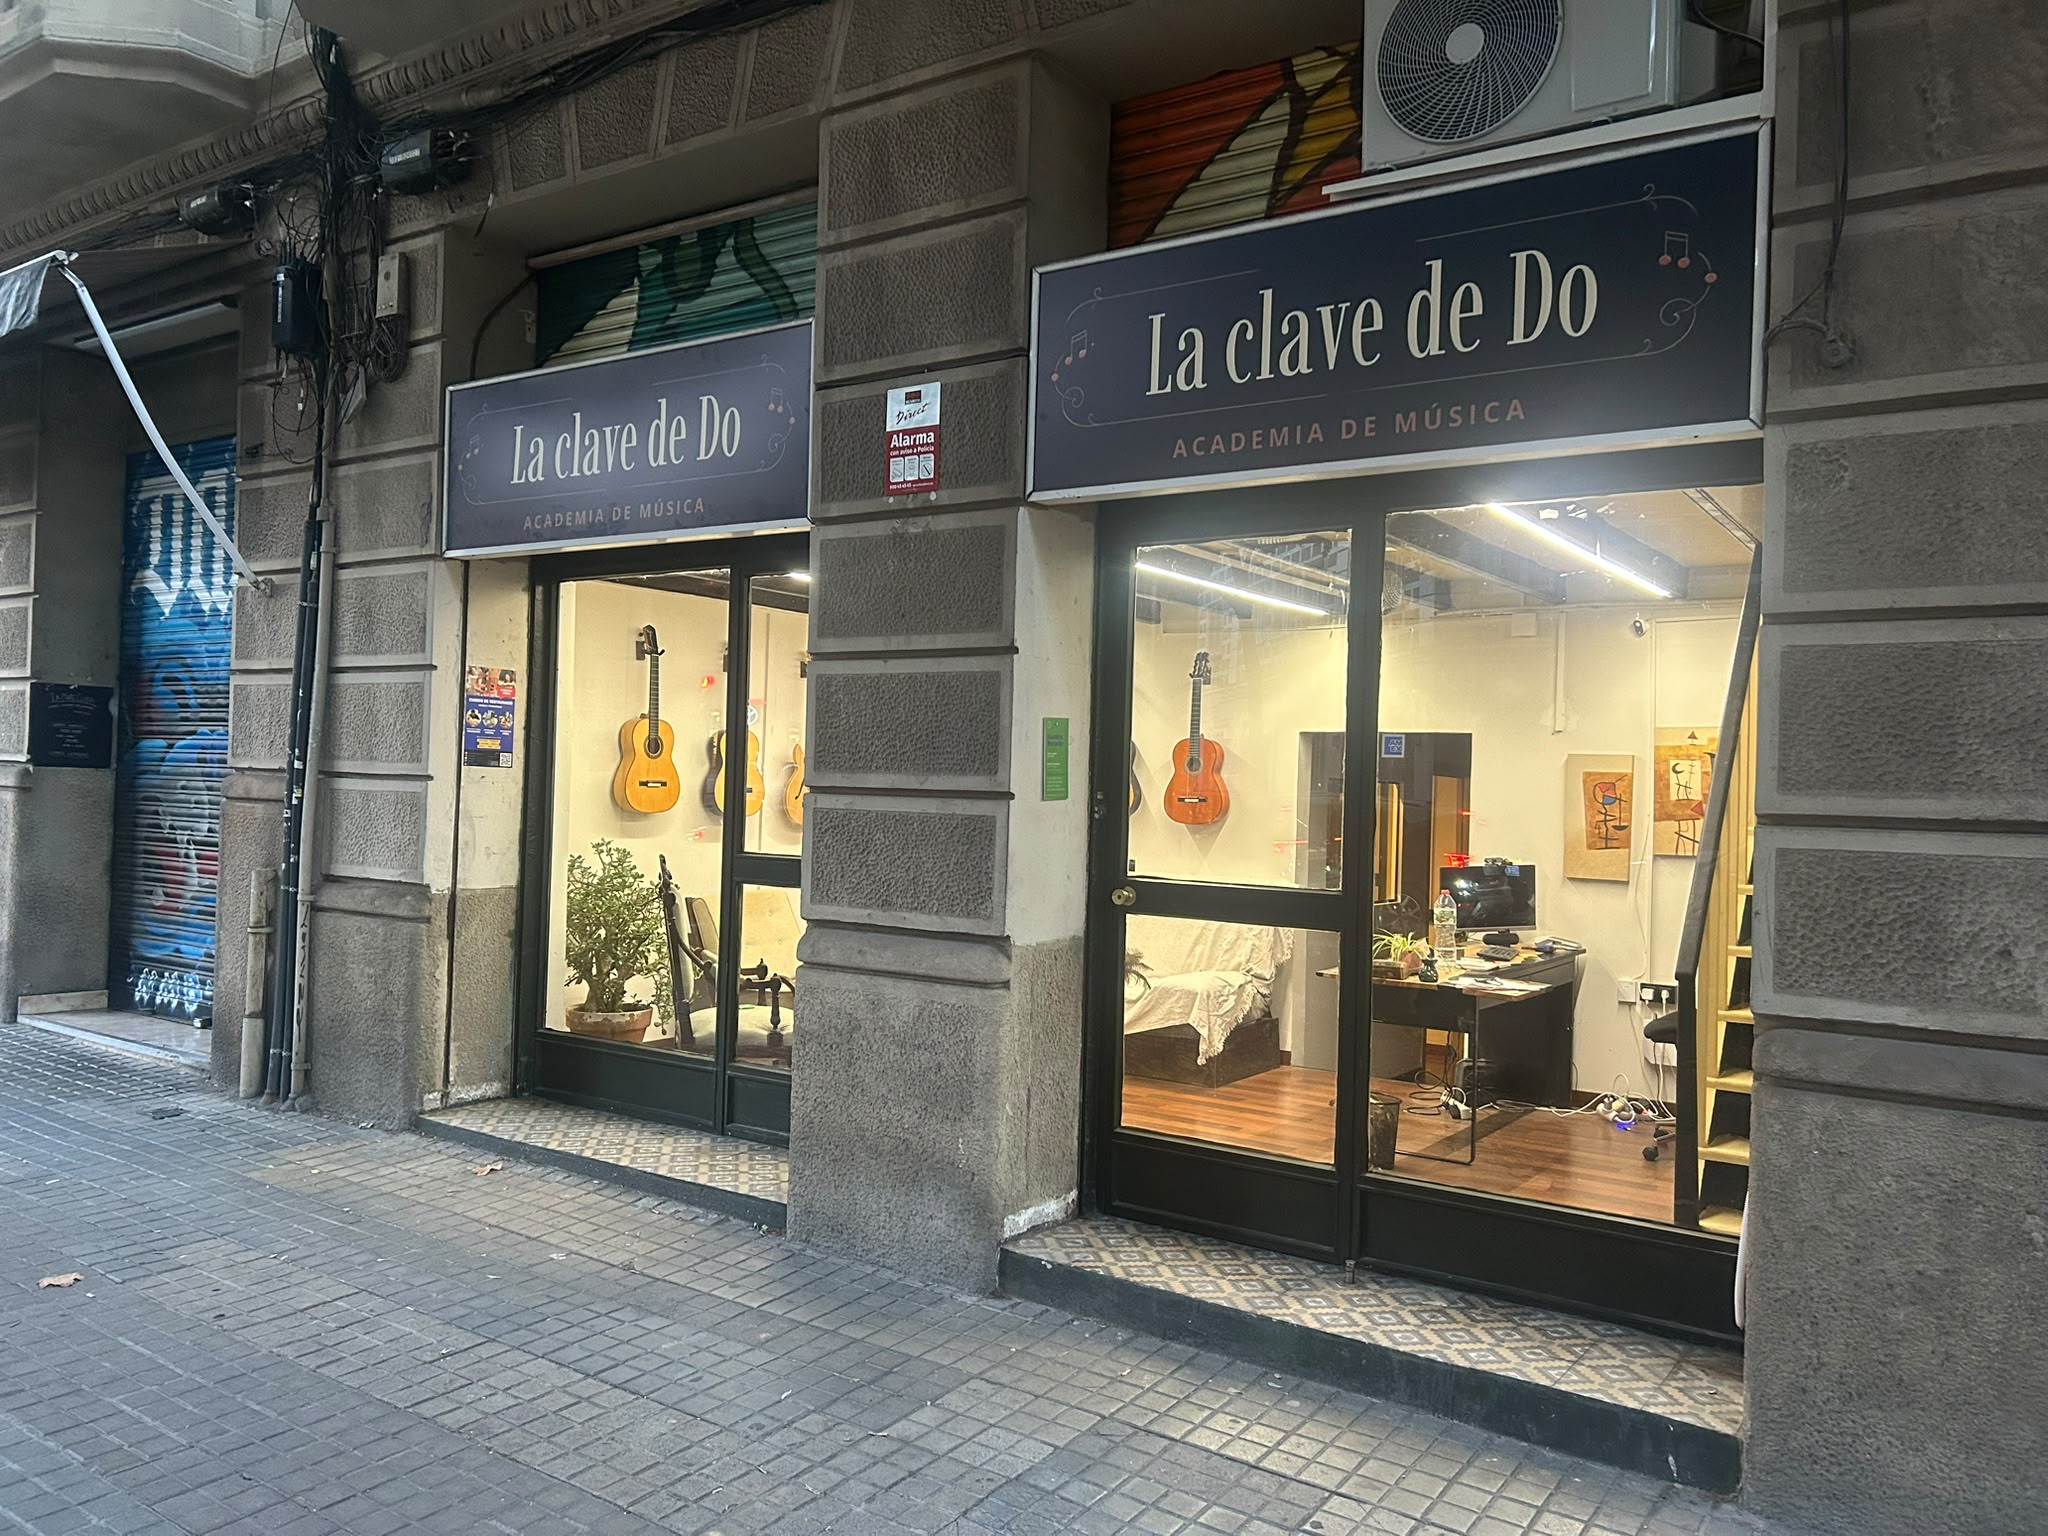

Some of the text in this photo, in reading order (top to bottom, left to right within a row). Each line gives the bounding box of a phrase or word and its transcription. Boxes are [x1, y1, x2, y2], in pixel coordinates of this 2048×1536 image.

[1145, 249, 1599, 396] La clave de Do
[896, 402, 930, 425] Direct
[1172, 398, 1527, 459] ACADEMIA DE MÚSICA
[510, 395, 741, 484] La clave de Do
[890, 432, 934, 448] Alarma
[900, 447, 912, 455] aviso
[918, 445, 934, 453] Policía
[523, 497, 704, 530] ACADEMIA DE MÚSICA
